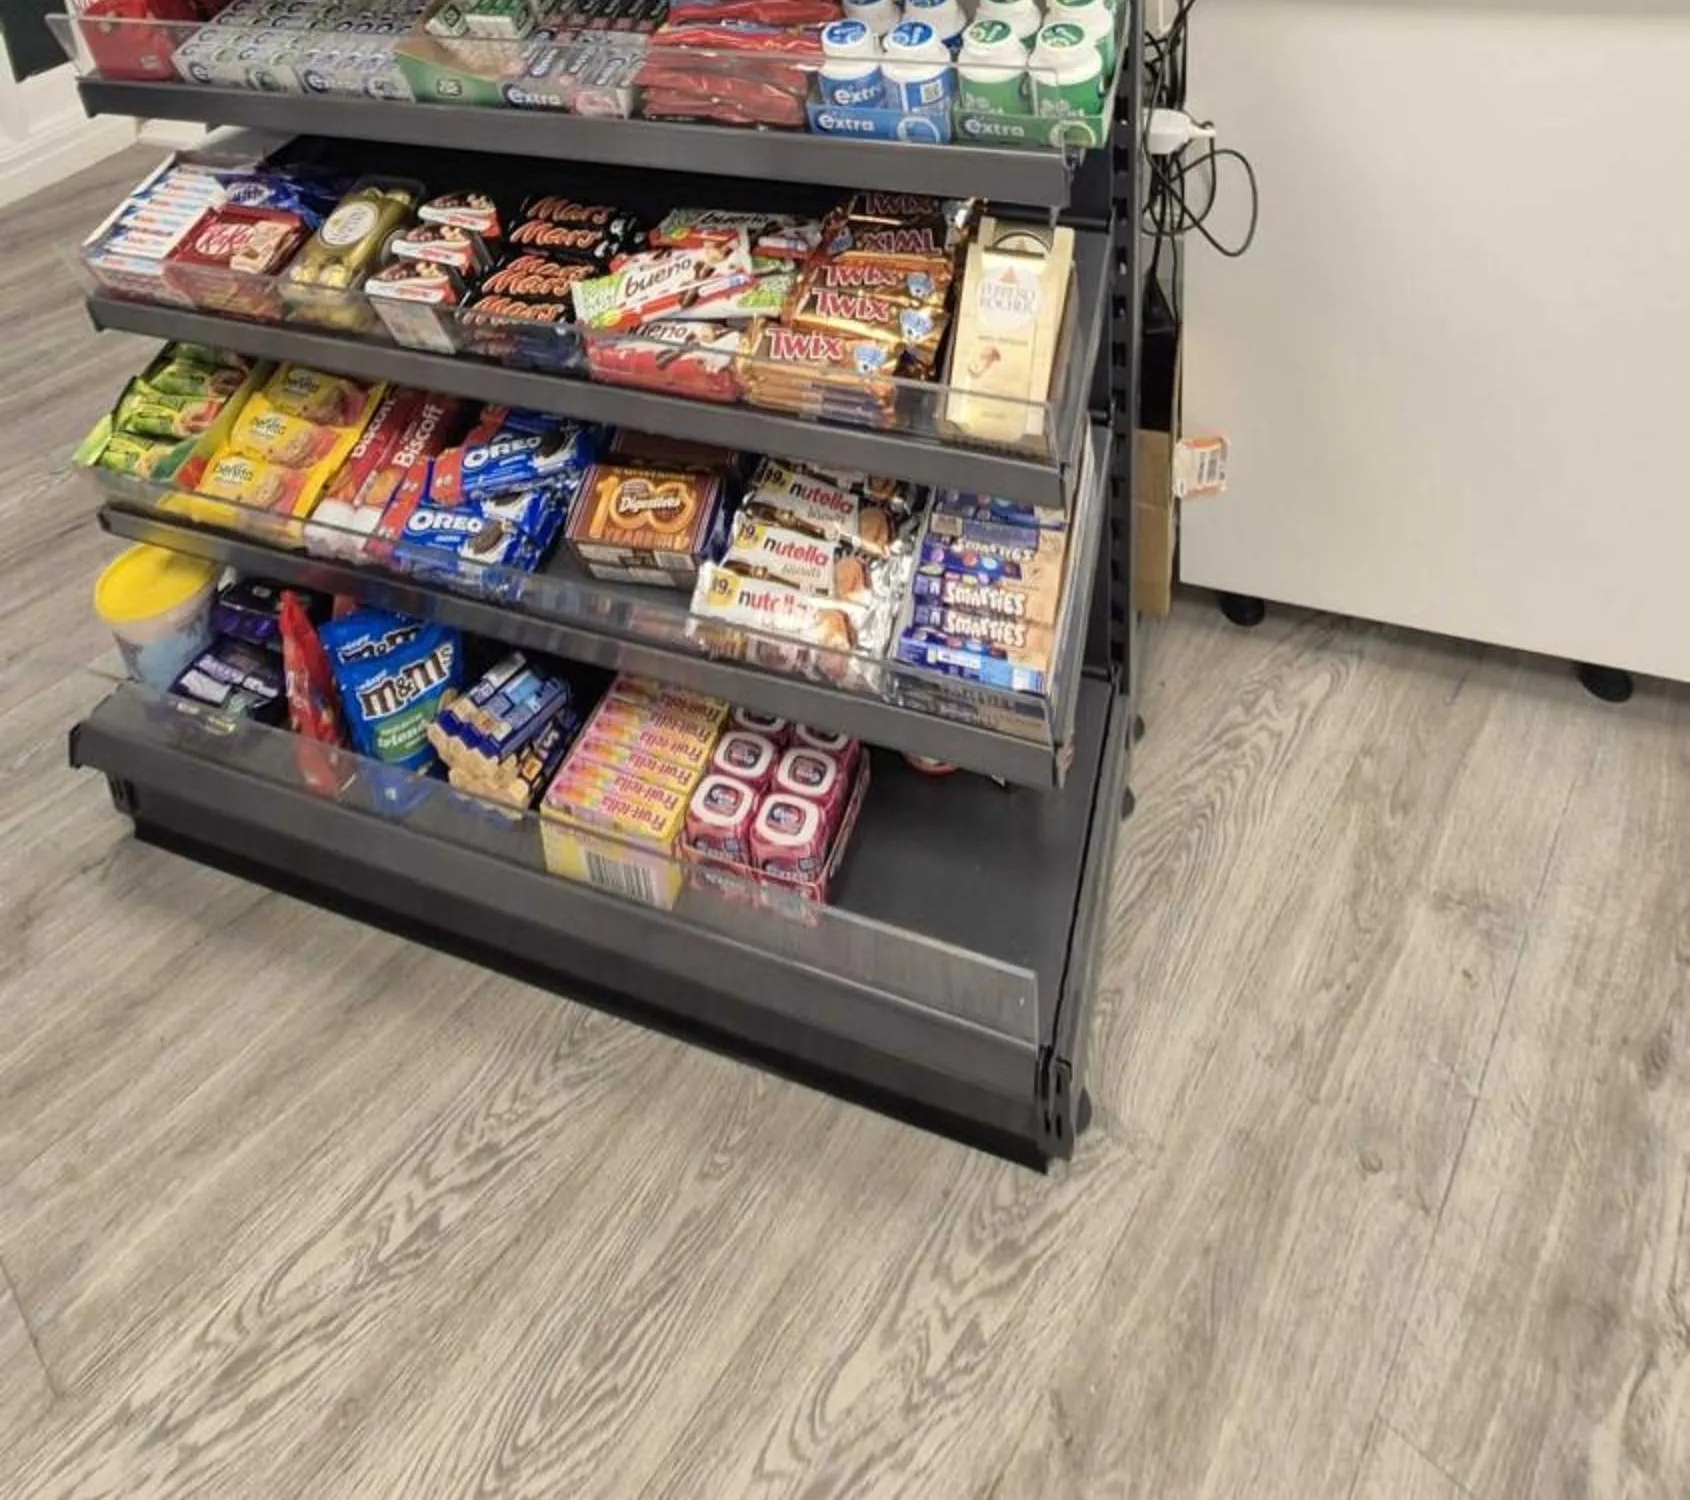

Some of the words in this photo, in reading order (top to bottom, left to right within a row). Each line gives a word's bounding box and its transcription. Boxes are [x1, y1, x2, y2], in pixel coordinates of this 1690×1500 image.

[818, 112, 875, 133] extra
[964, 118, 1026, 137] extra
[481, 266, 575, 297] Mars
[625, 259, 691, 297] bueno
[822, 264, 897, 287] Twix
[812, 288, 889, 321] Twix
[767, 328, 845, 360] Twix
[392, 404, 445, 468] Biscoff
[789, 483, 854, 514] nutella
[408, 510, 483, 534] OREO
[763, 537, 830, 567] nutella
[944, 581, 1026, 617] SMARTIES
[944, 608, 1026, 648] SMARTIES
